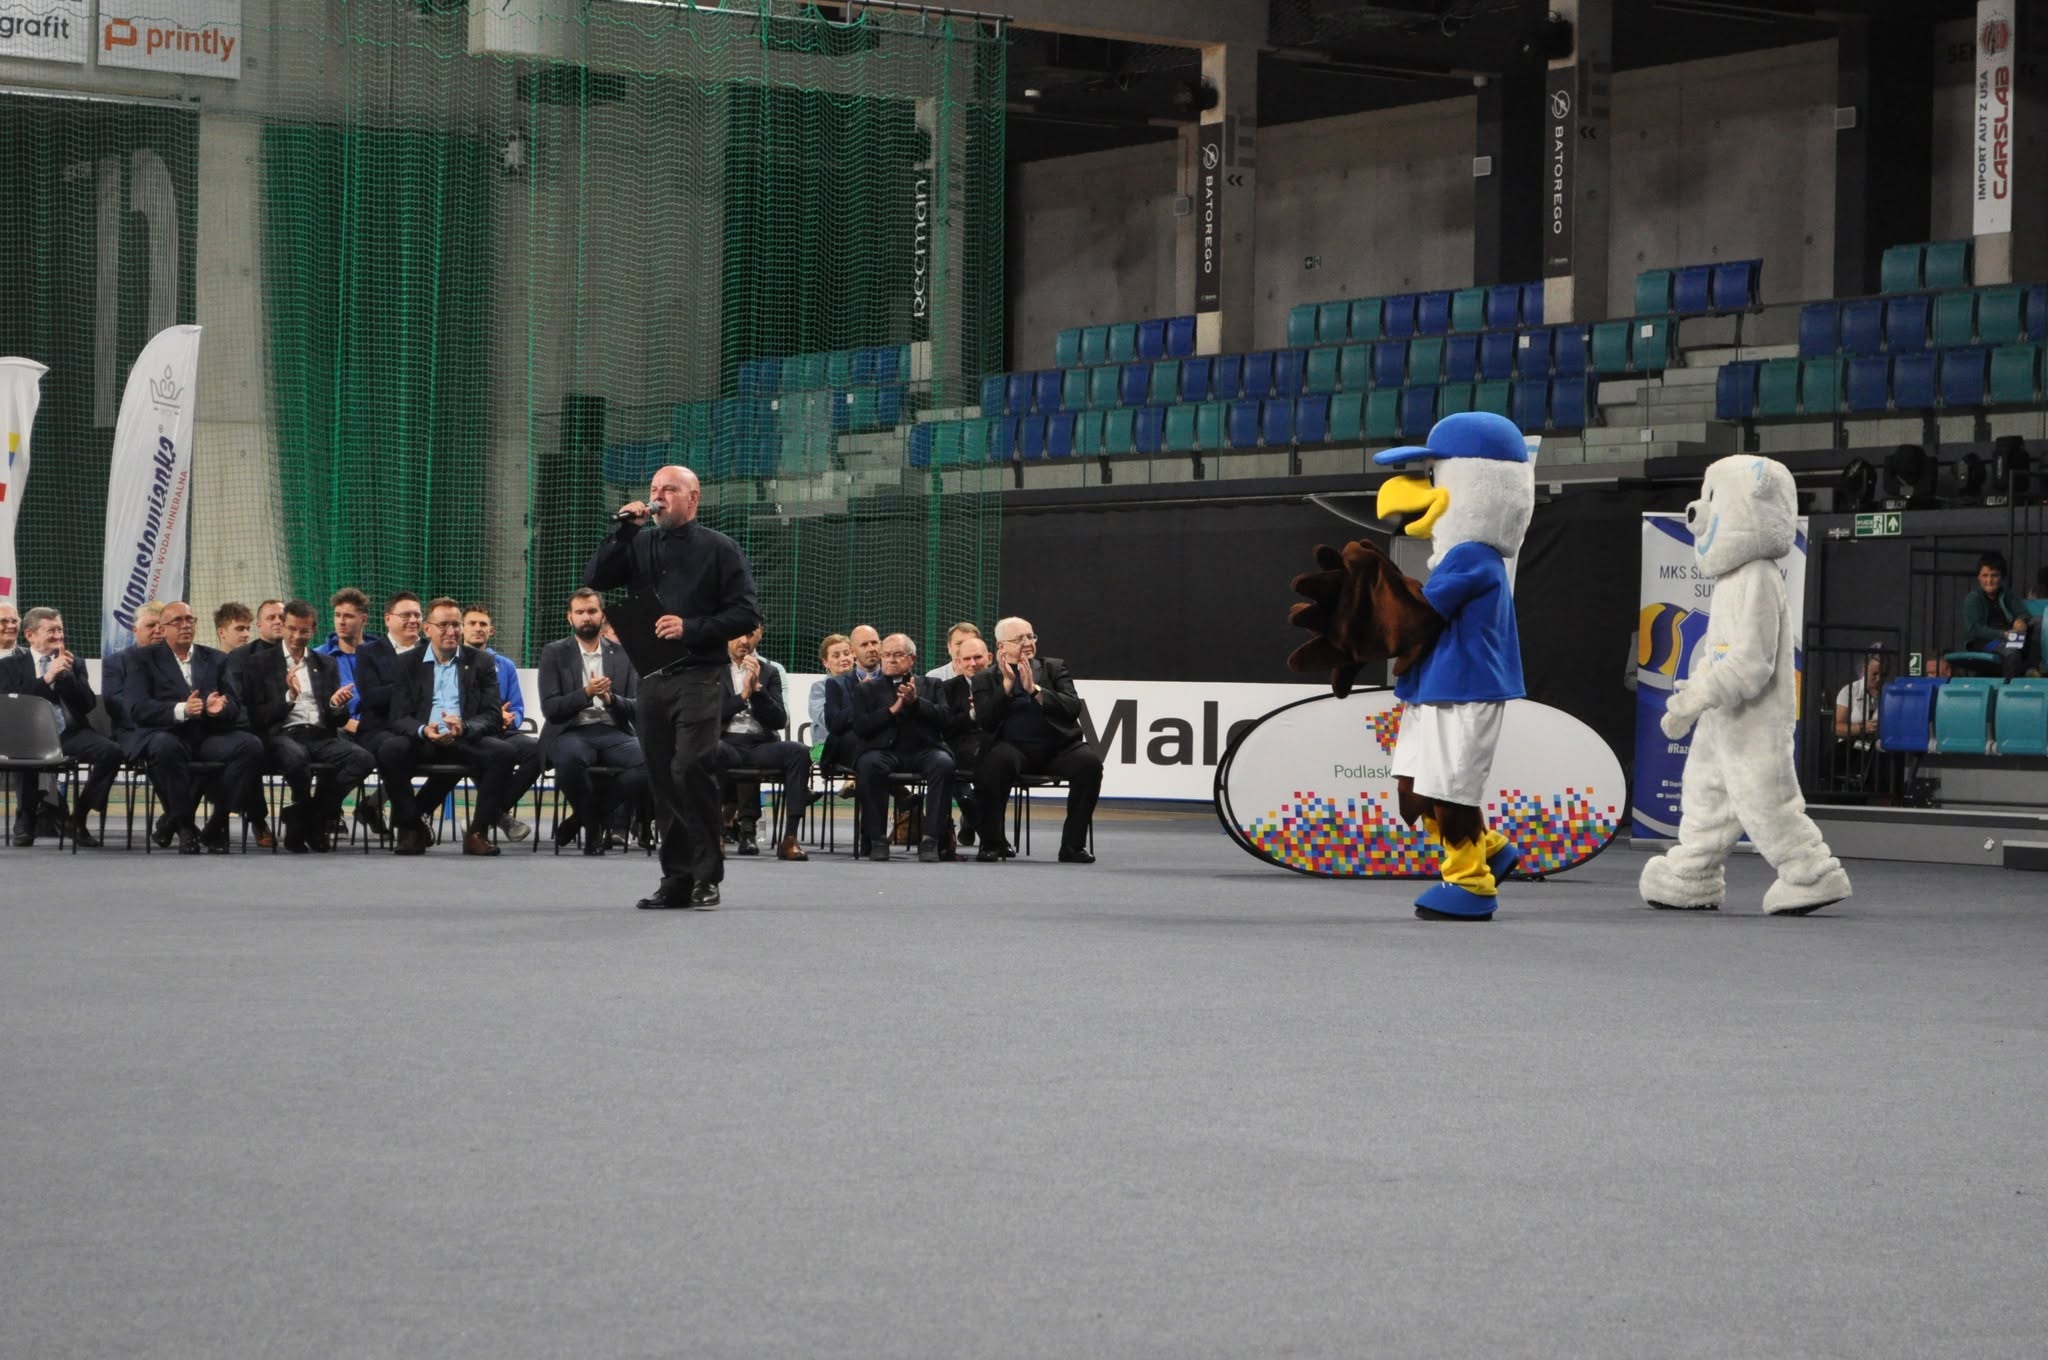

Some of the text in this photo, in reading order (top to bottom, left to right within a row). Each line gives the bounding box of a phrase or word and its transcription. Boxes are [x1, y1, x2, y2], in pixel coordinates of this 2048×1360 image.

[146, 27, 236, 62] printly
[1553, 126, 1564, 234] BATOREGO
[1978, 70, 1989, 200] IMPORT AUT Z USA
[1993, 66, 2010, 200] CARSLAB
[1204, 175, 1214, 274] BATOREGO
[157, 532, 171, 564] WODA
[166, 470, 188, 530] MINERALNA
[1659, 565, 1687, 580] MKS
